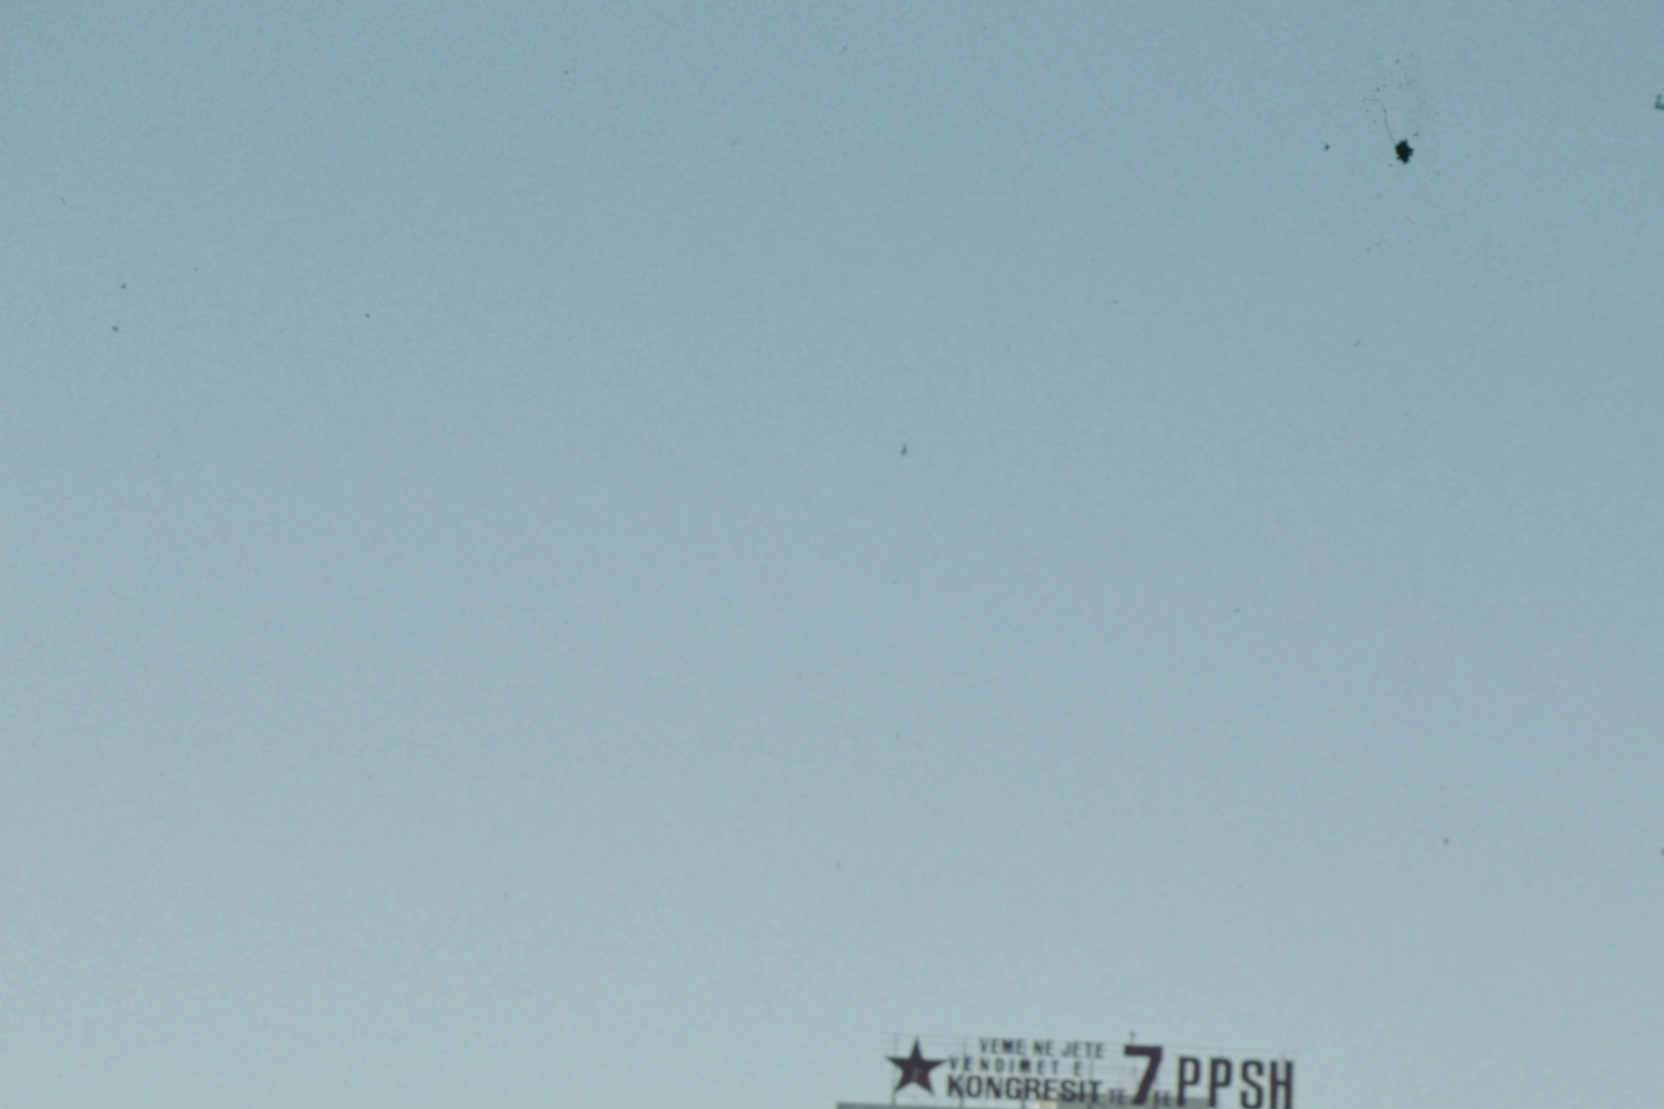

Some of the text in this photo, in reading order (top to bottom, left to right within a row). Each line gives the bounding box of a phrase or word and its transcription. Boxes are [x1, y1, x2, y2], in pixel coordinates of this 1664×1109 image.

[946, 1074, 1103, 1103] KONGRESIT
[1123, 1045, 1163, 1106] 7
[948, 1056, 1083, 1077] VENDIMET E
